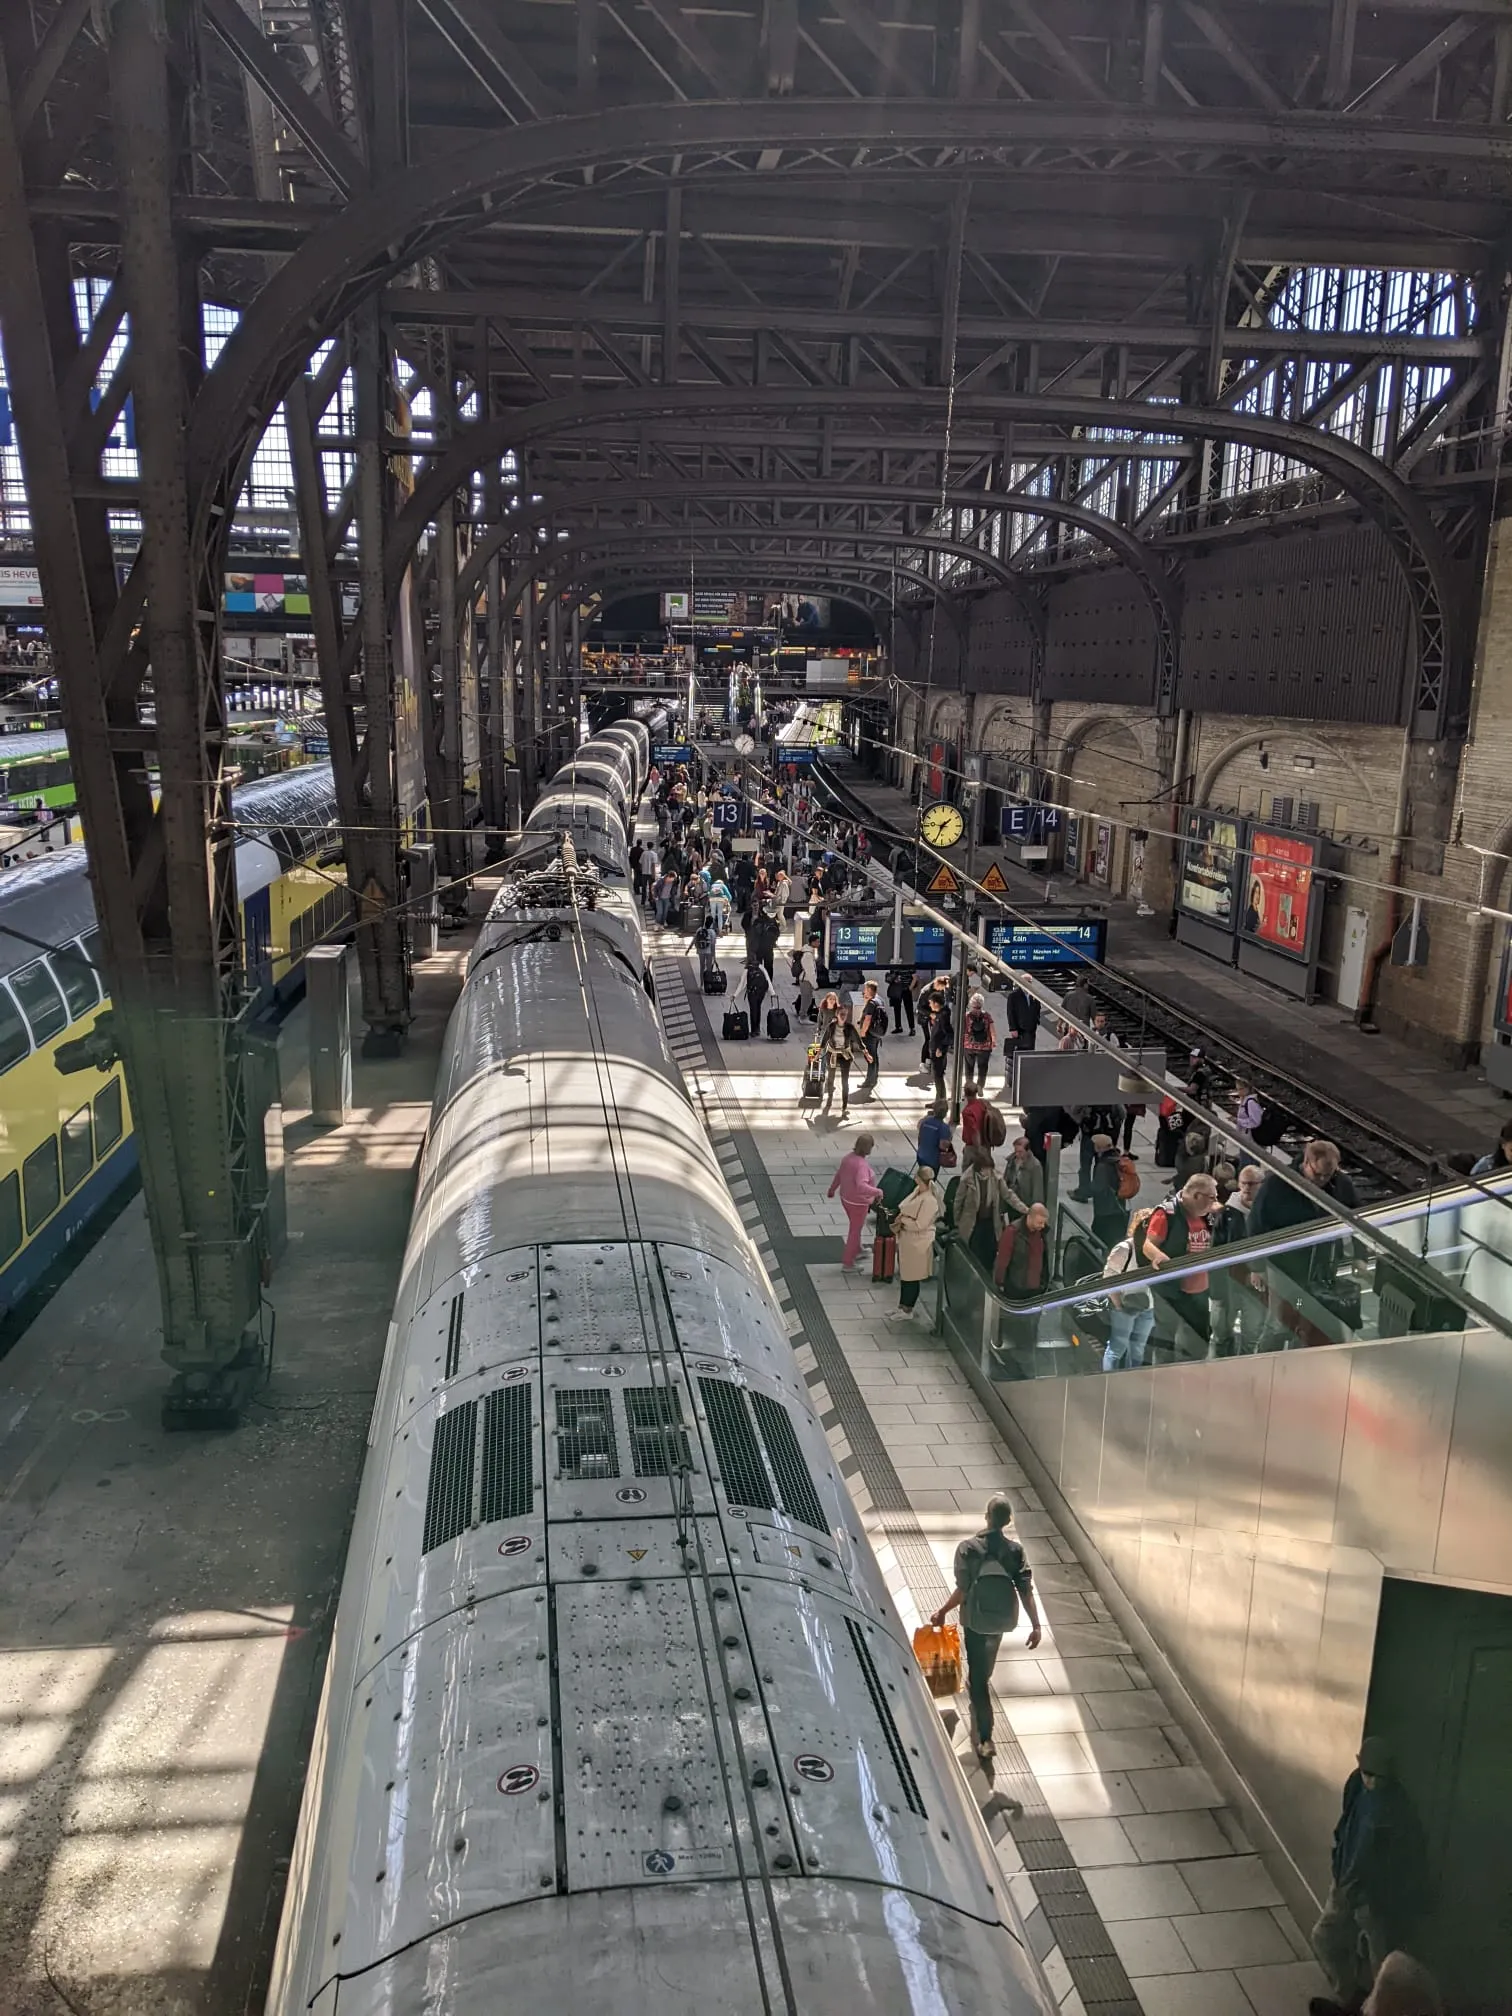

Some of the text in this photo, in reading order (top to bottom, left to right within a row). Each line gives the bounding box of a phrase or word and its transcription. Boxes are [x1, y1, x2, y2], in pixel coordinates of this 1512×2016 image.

[717, 804, 738, 823] 13
[1011, 809, 1025, 830] E
[1036, 808, 1058, 827] 14
[838, 927, 851, 940] 13
[858, 935, 874, 943] Nicht
[1078, 926, 1091, 938] 14
